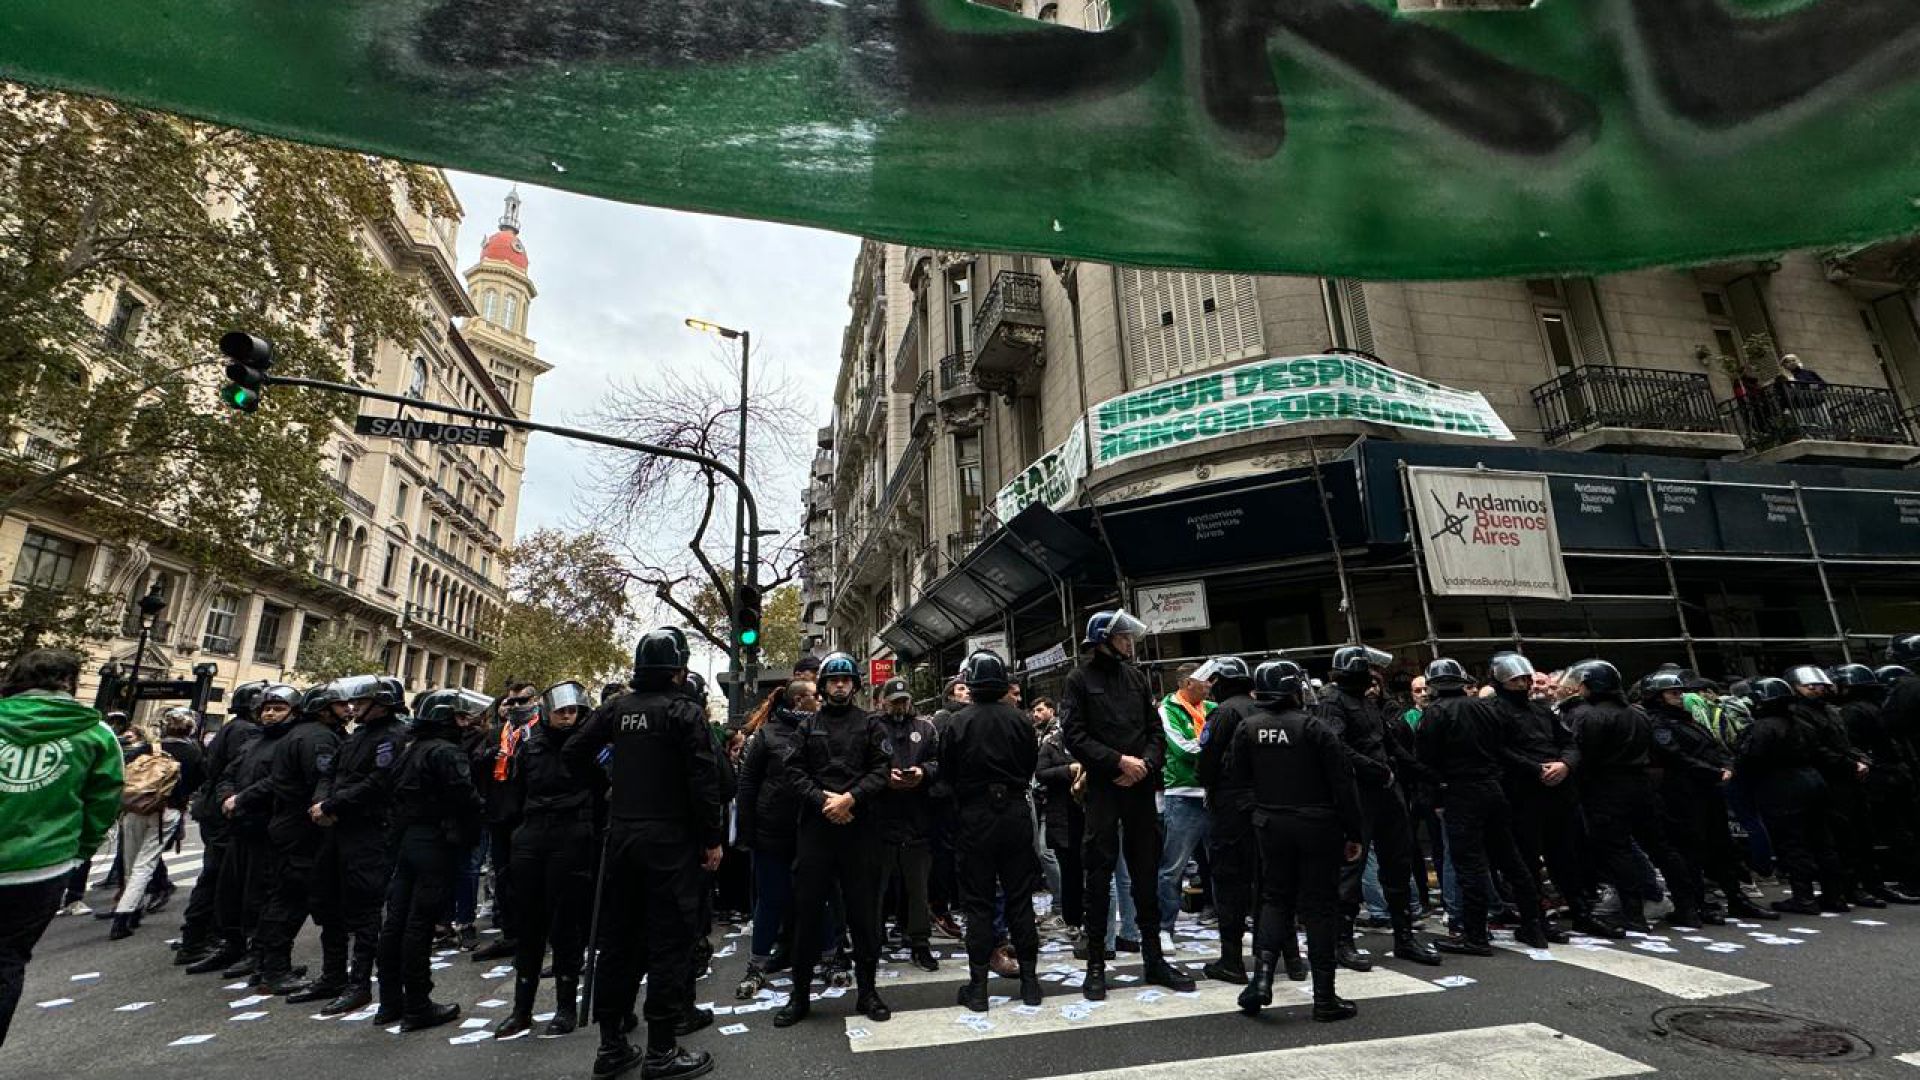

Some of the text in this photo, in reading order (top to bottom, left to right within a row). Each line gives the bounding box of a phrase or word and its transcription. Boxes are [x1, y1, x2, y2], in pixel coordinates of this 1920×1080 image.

[370, 418, 492, 445] SAN JOSE
[1455, 490, 1548, 514] Andamios
[1475, 509, 1547, 531] Buenos
[1472, 527, 1521, 547] Aires
[621, 713, 648, 731] PFA
[1258, 728, 1290, 744] PFA
